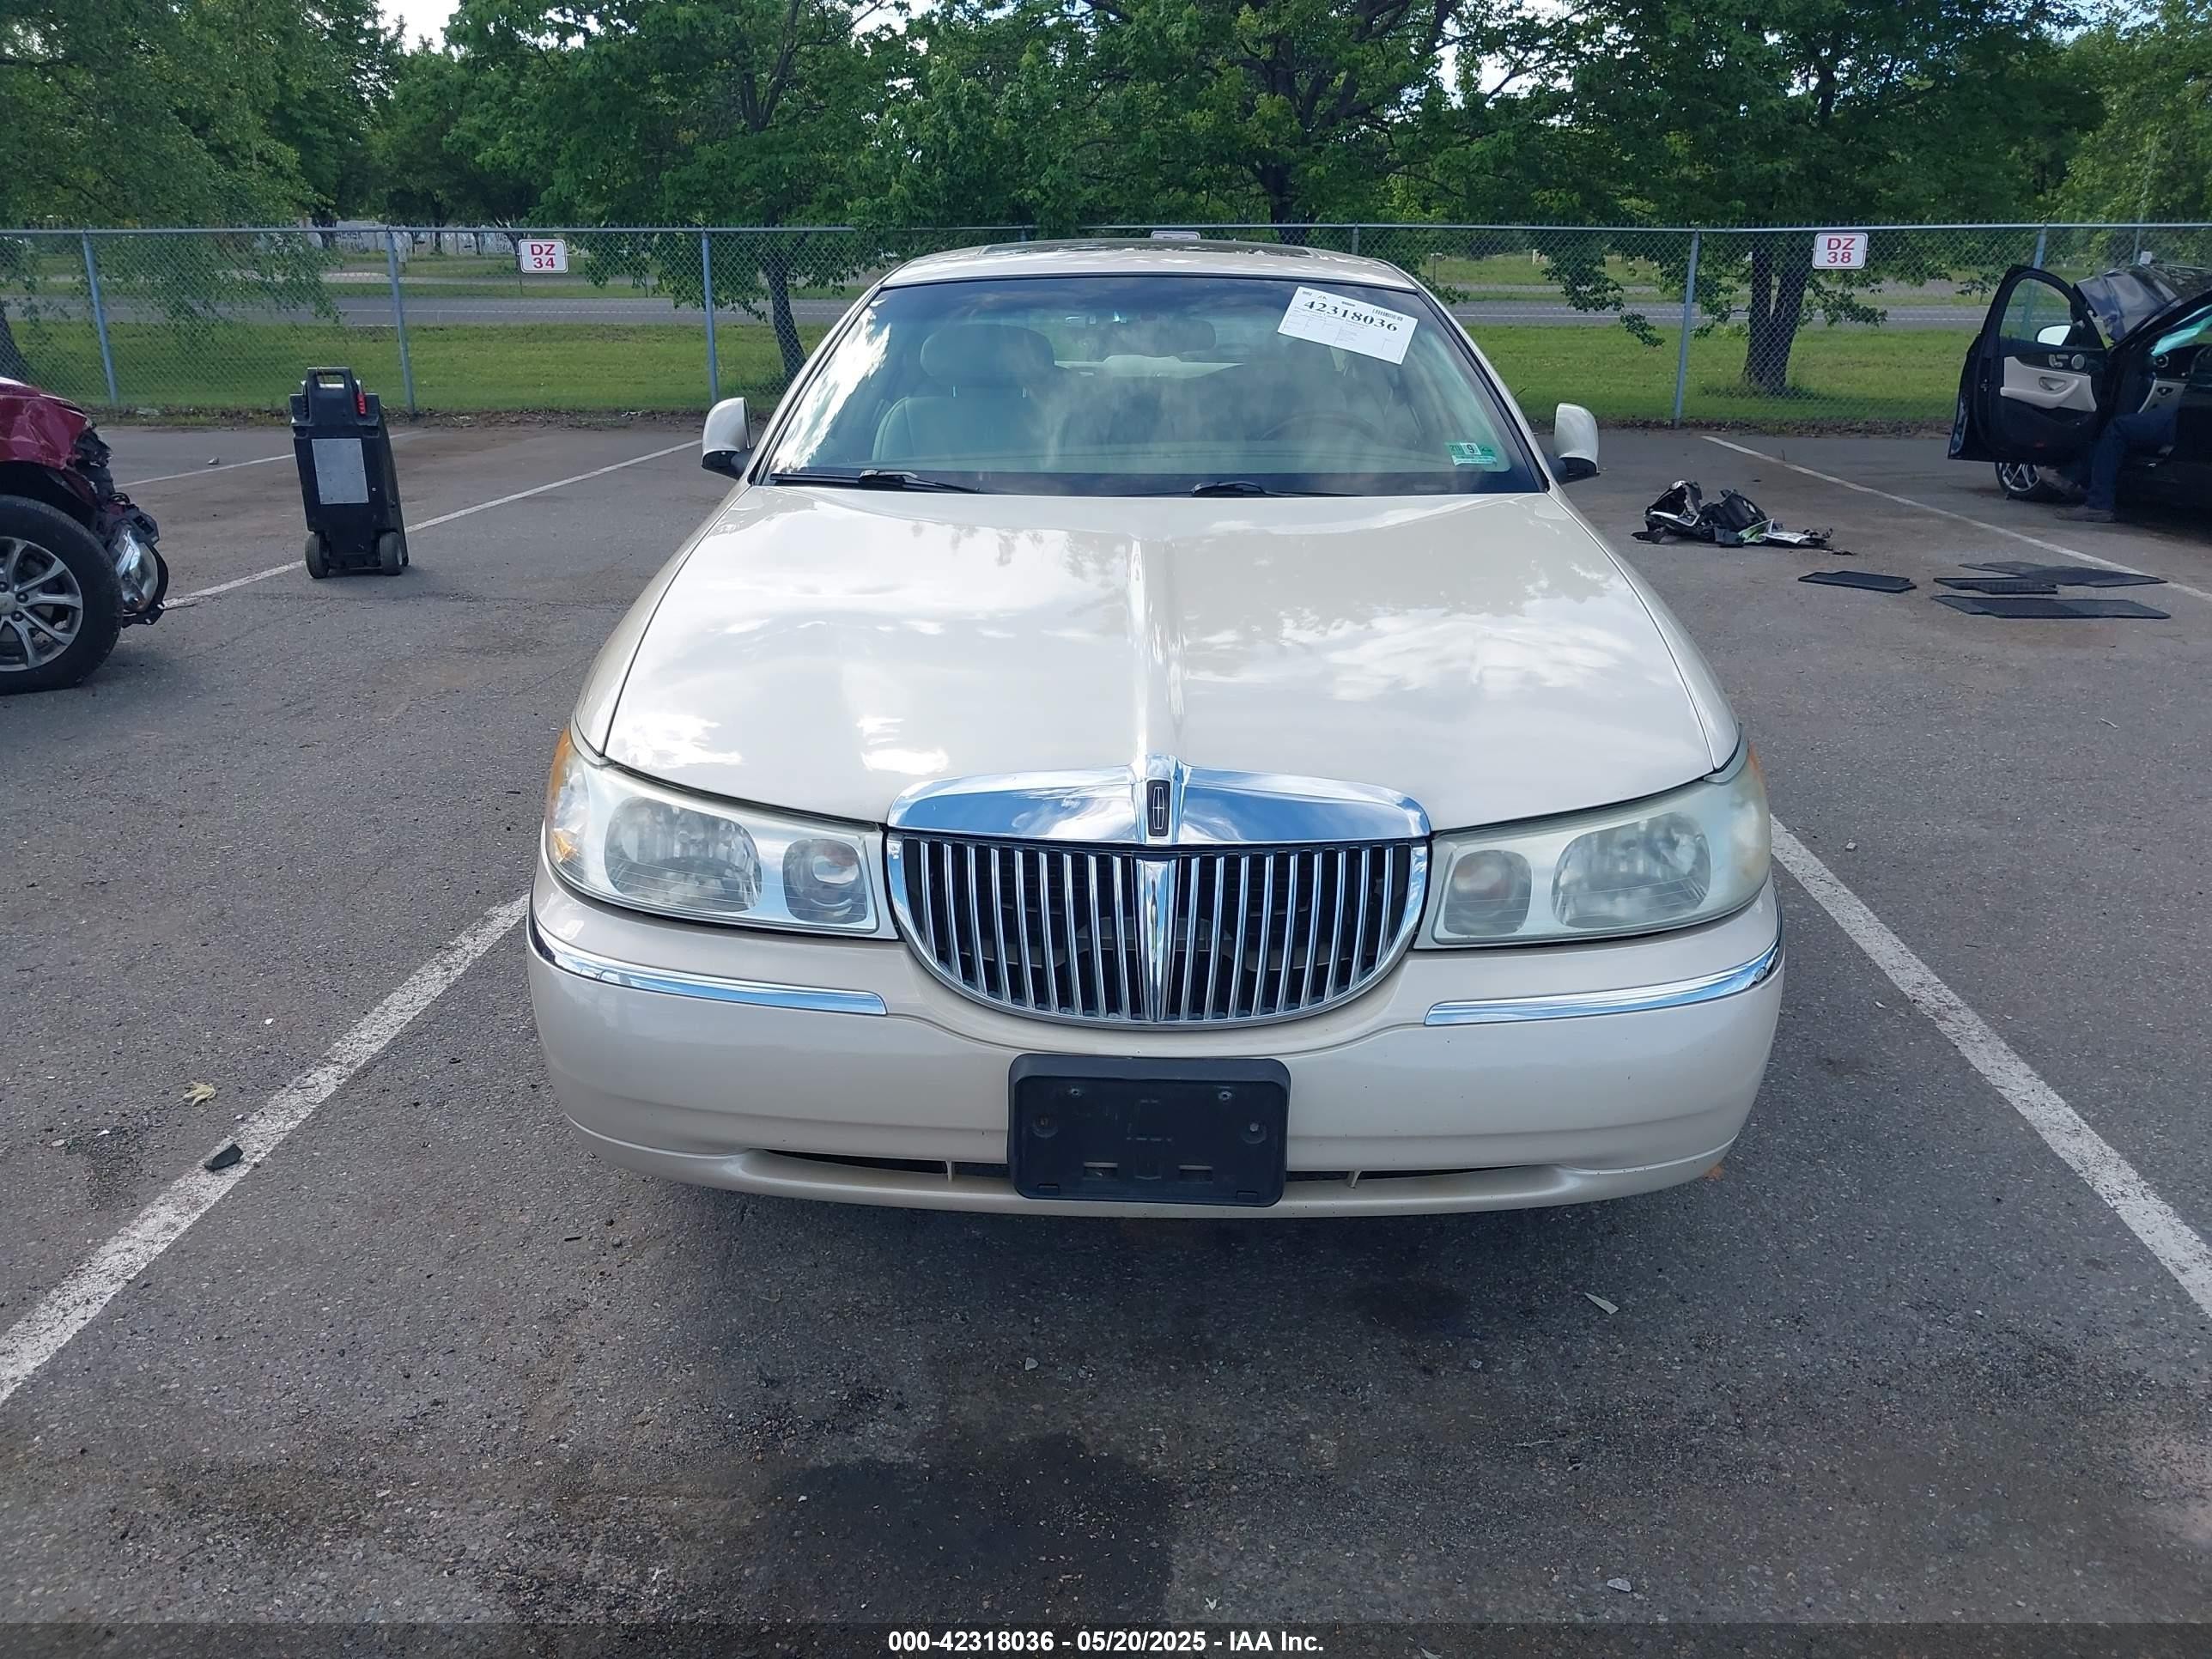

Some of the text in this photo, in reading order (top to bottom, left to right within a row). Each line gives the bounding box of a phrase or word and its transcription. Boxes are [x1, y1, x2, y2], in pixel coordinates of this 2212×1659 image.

[530, 244, 556, 256] DZ
[1826, 237, 1856, 251] DZ
[532, 257, 556, 269] 34
[1826, 252, 1851, 264] 38
[1304, 301, 1398, 331] 42318036
